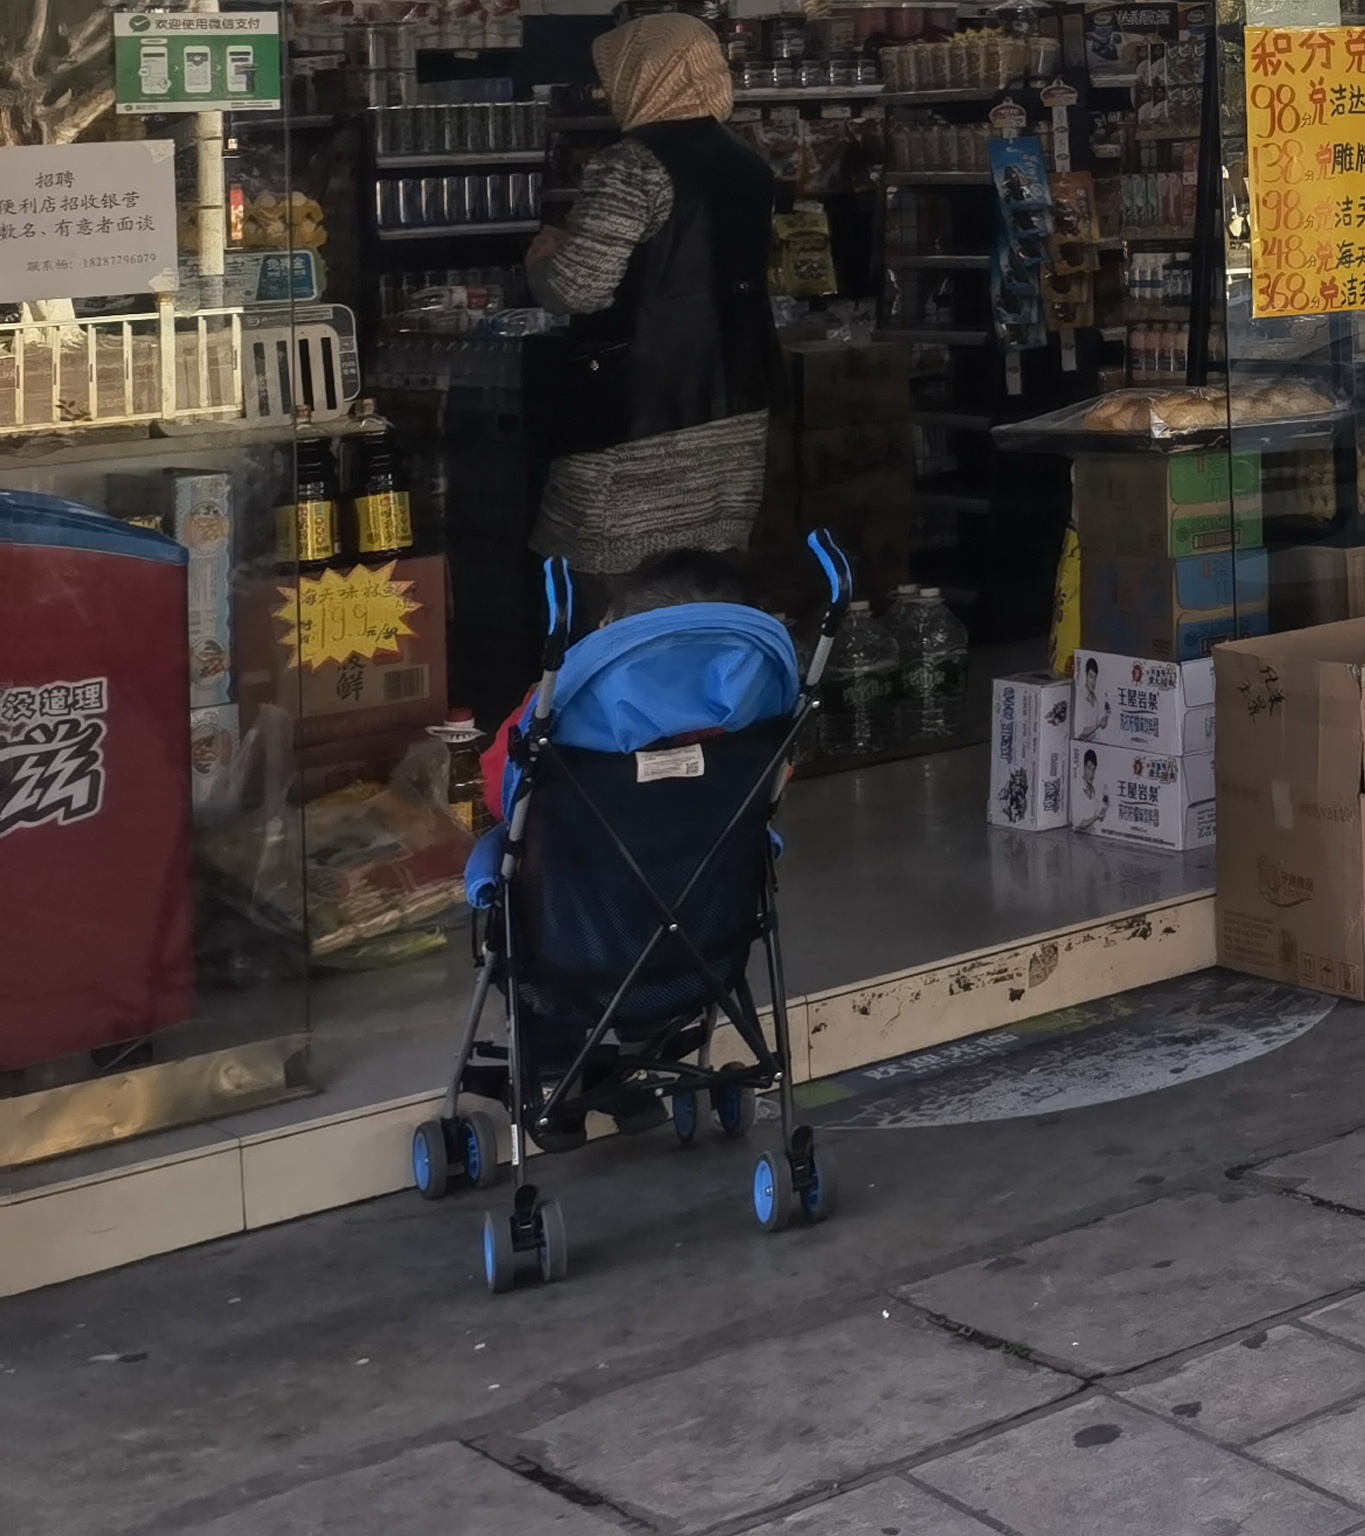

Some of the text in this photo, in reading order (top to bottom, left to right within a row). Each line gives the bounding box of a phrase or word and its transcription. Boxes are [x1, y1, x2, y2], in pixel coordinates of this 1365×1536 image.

[154, 18, 261, 30] 欢迎使用微信支付
[35, 170, 75, 189] 招聘
[3, 681, 104, 721] 没道理
